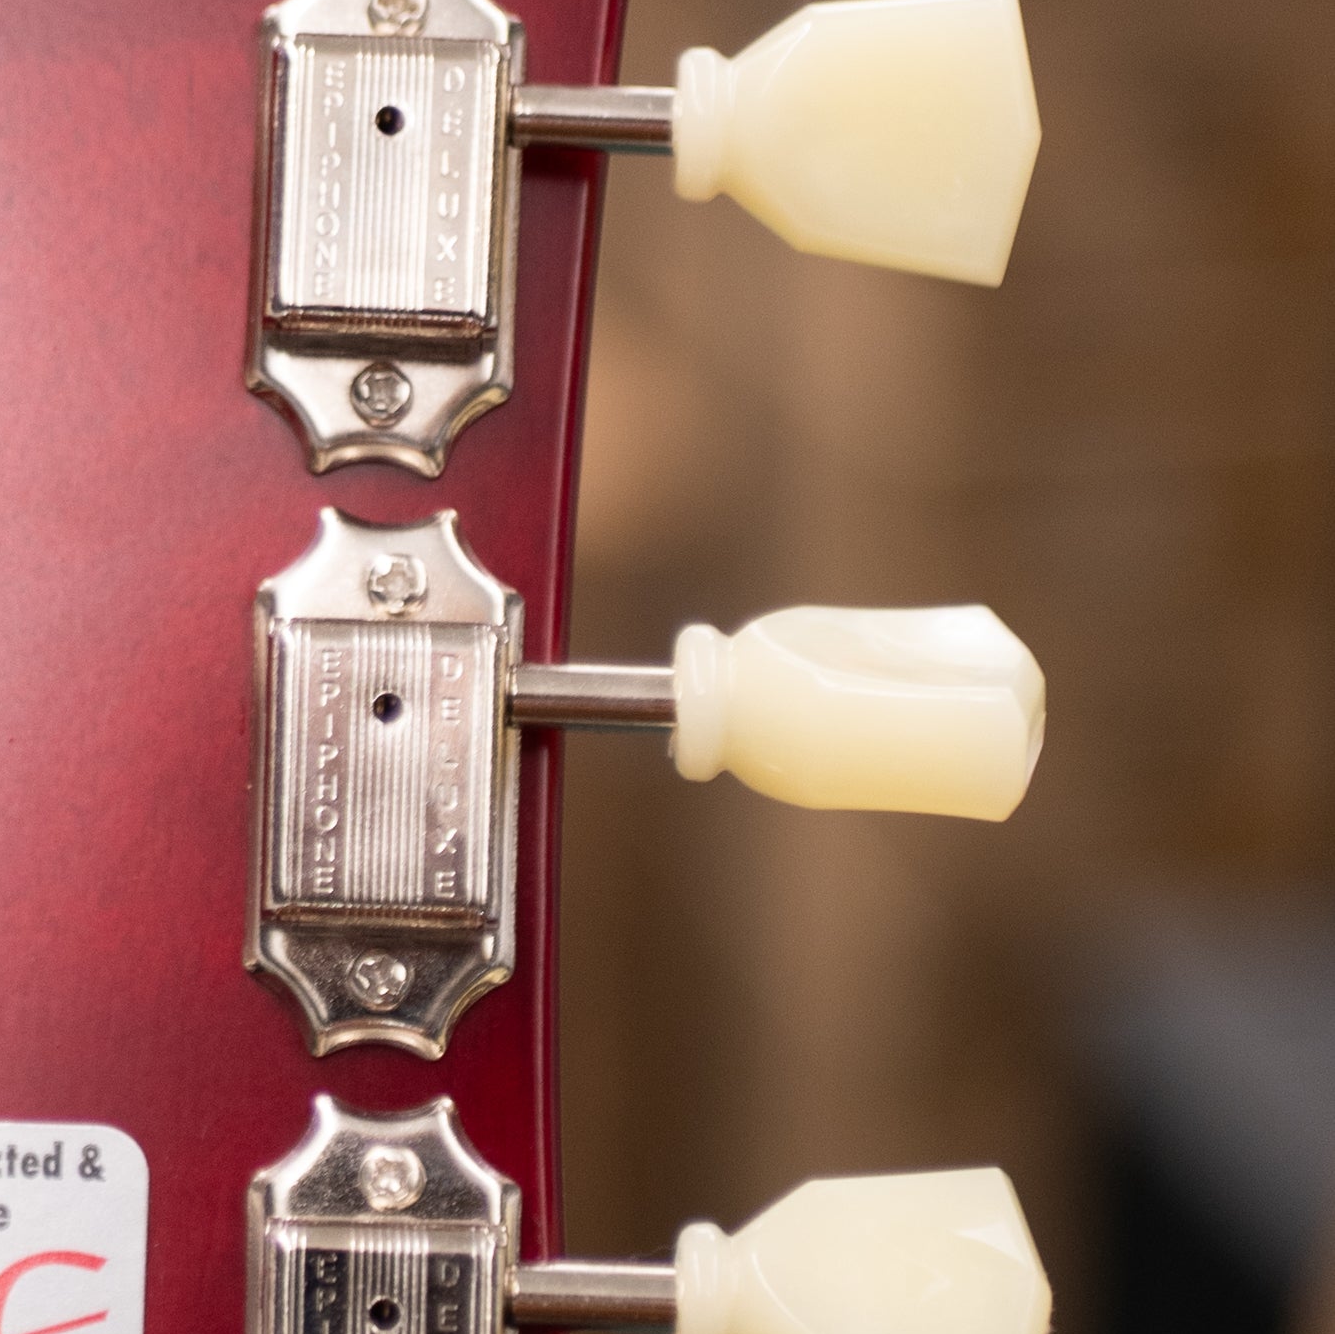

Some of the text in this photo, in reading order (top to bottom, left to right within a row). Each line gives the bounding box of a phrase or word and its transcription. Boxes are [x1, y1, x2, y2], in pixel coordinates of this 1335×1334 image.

[312, 61, 346, 301] EPIPHONE
[432, 66, 466, 307] DELUXE
[312, 648, 343, 896] EPIPHONE
[432, 654, 464, 900] DELUXE
[77, 1143, 106, 1182] &
